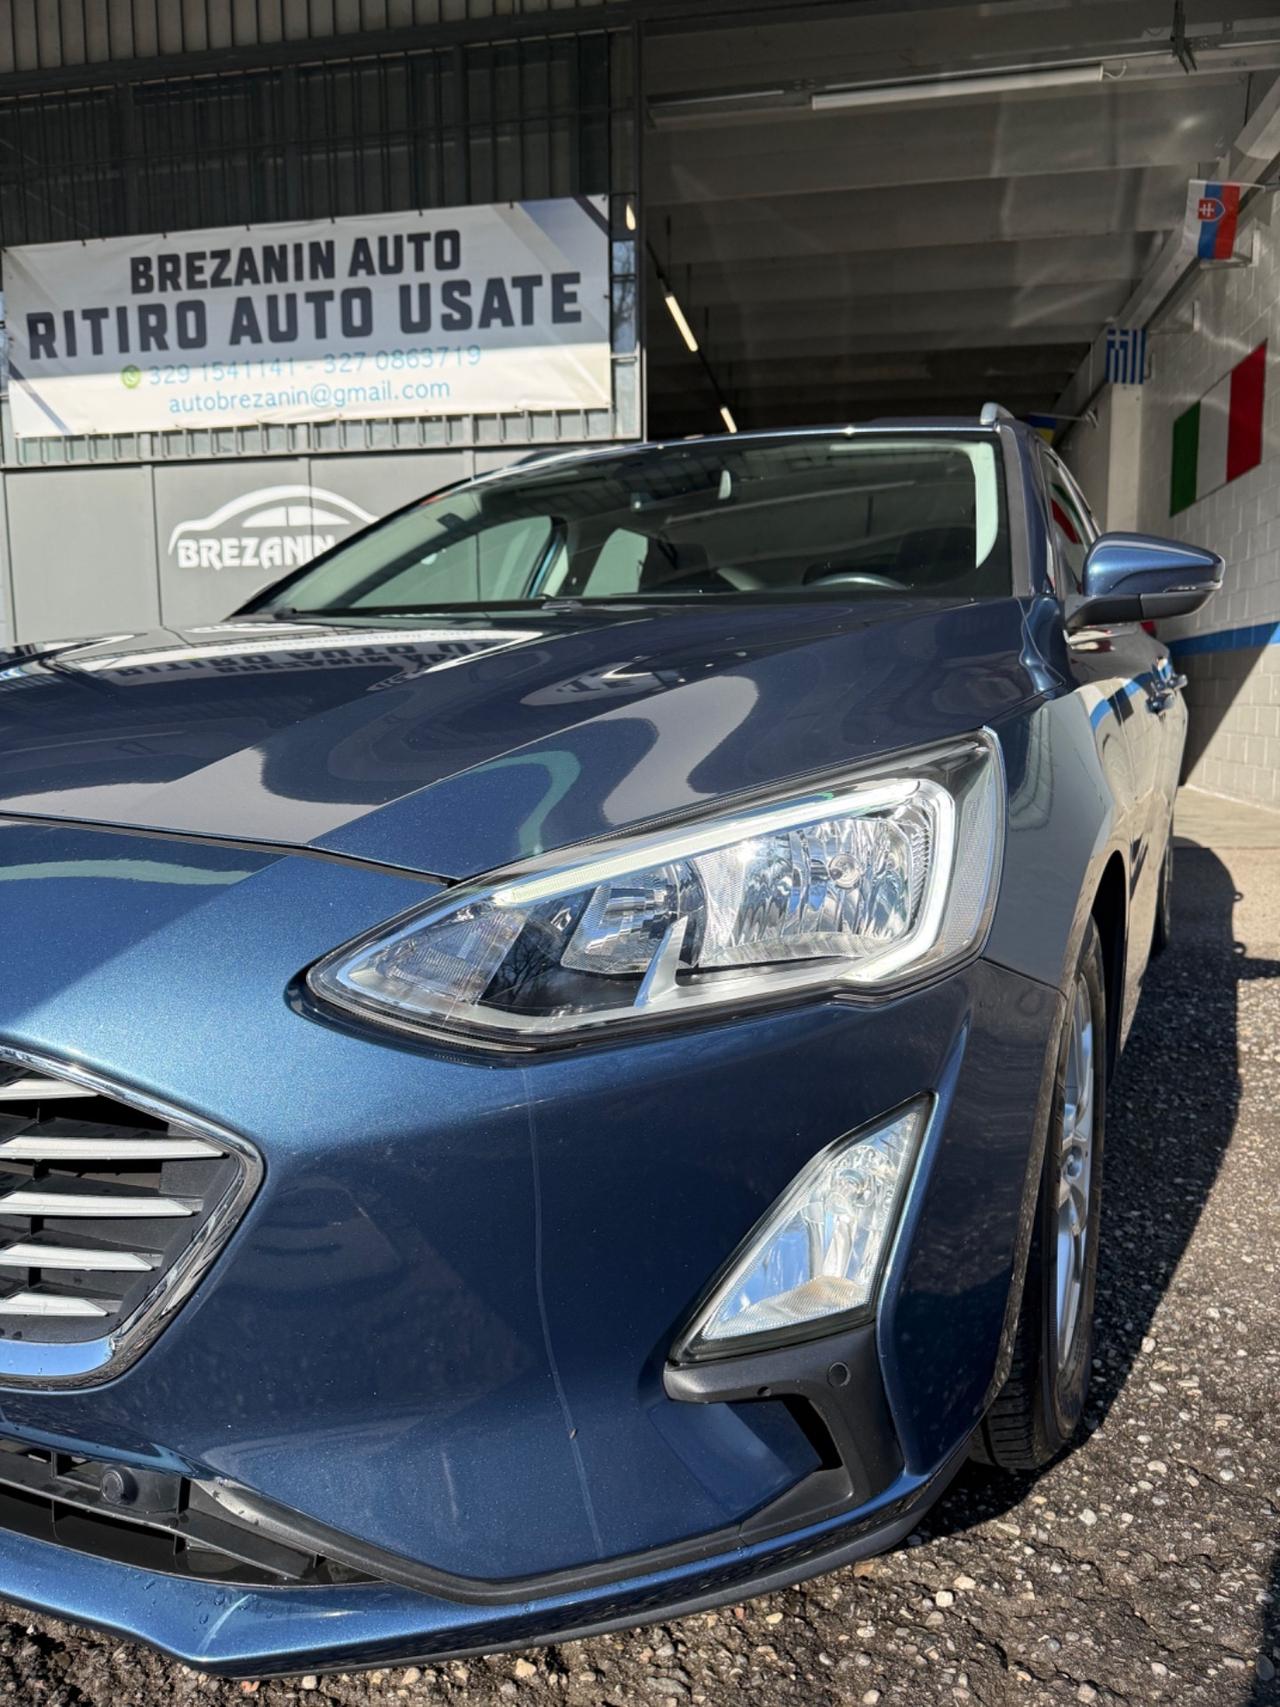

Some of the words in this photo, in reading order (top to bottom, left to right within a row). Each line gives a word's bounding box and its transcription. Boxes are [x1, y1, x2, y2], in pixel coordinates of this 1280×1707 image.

[130, 239, 335, 295] BREZANIN
[348, 229, 460, 277] AUTO
[26, 299, 208, 360] RITIRO
[229, 286, 373, 345] AUTO
[399, 271, 582, 334] USATE
[149, 363, 190, 385] 329
[202, 357, 294, 382] 1541141
[323, 351, 366, 374] 327
[375, 344, 481, 371] 0863719
[169, 380, 450, 413] autobrezanin@gmail.com
